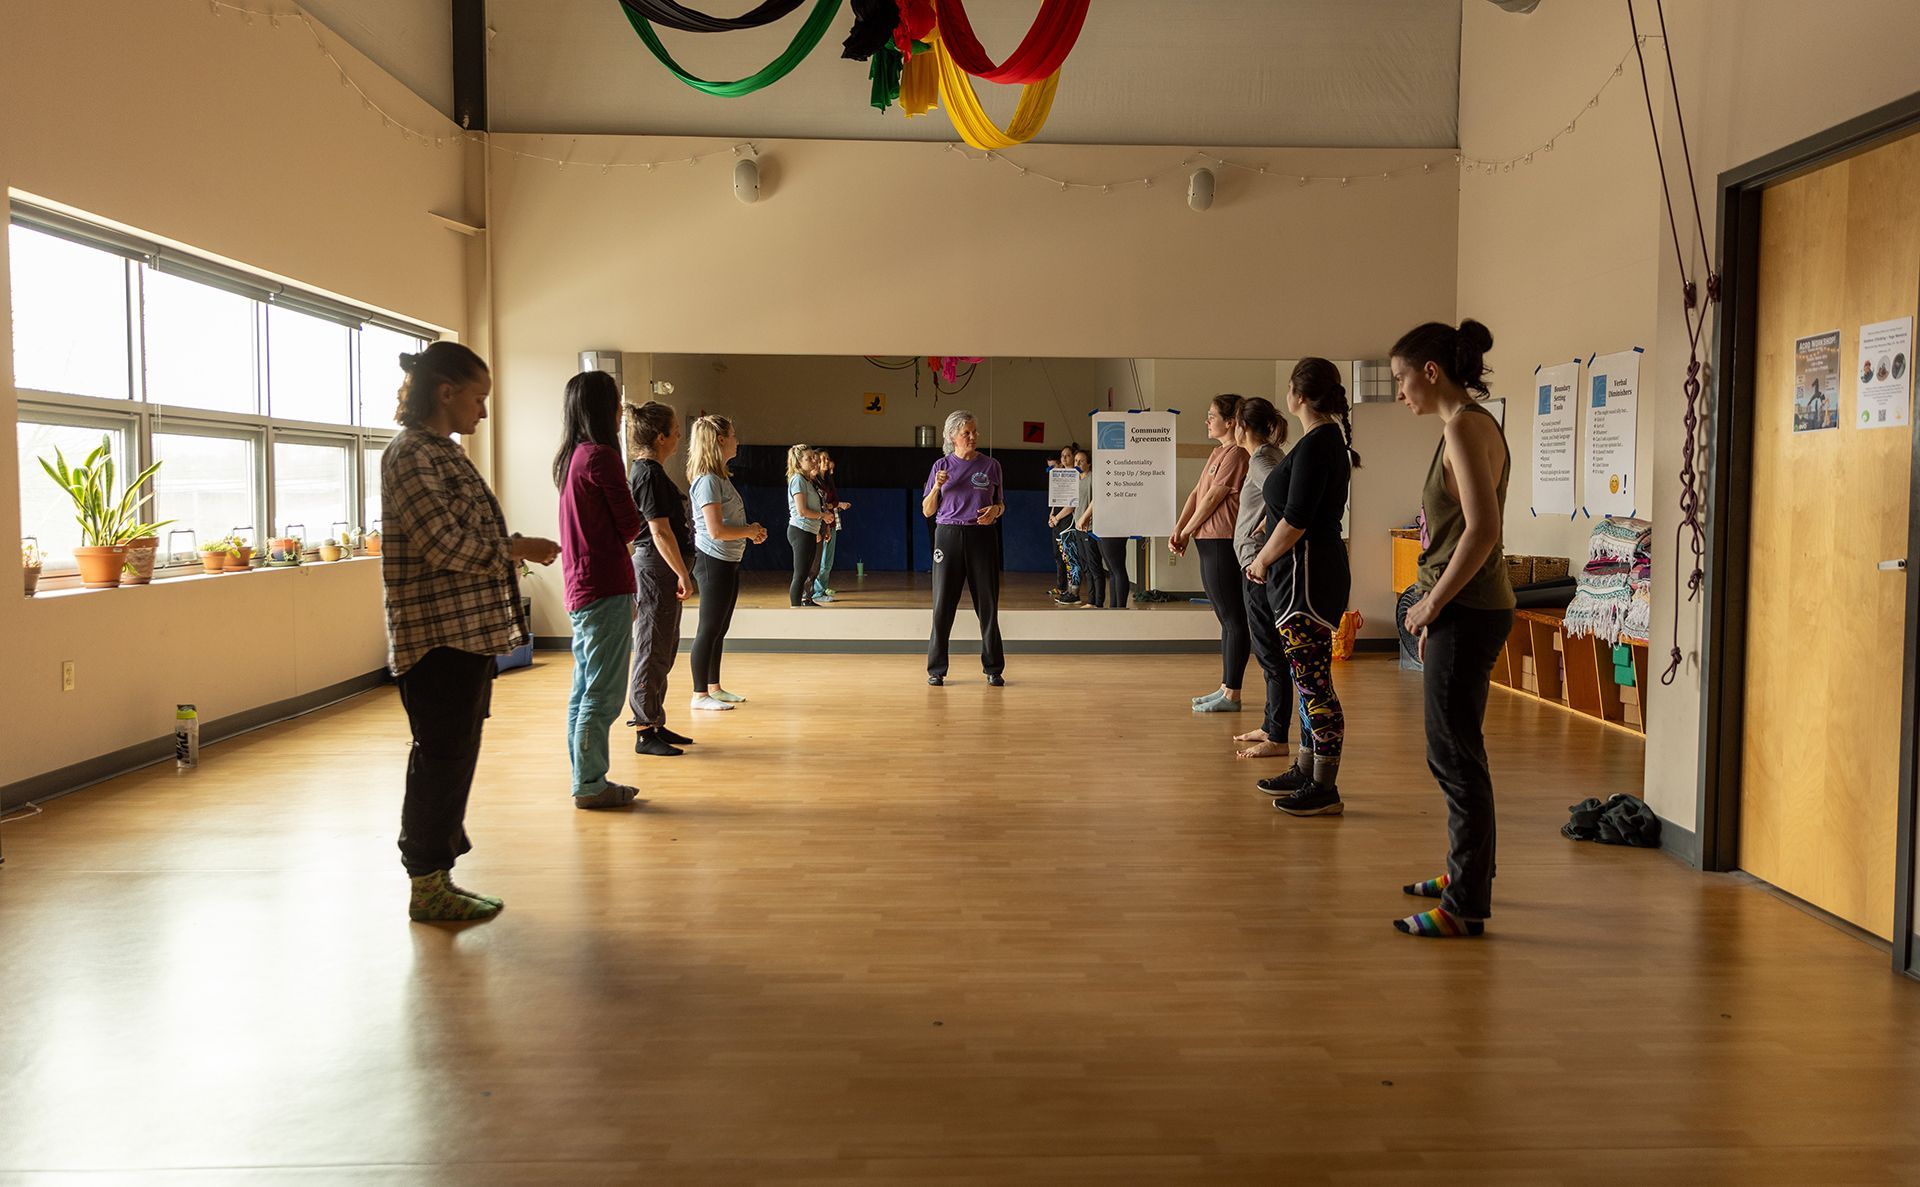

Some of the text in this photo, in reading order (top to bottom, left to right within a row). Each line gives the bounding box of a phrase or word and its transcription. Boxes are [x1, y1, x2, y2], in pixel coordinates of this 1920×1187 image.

[1614, 379, 1627, 387] Verbal
[1608, 389, 1632, 397] Diminishers
[1131, 427, 1171, 435] Community
